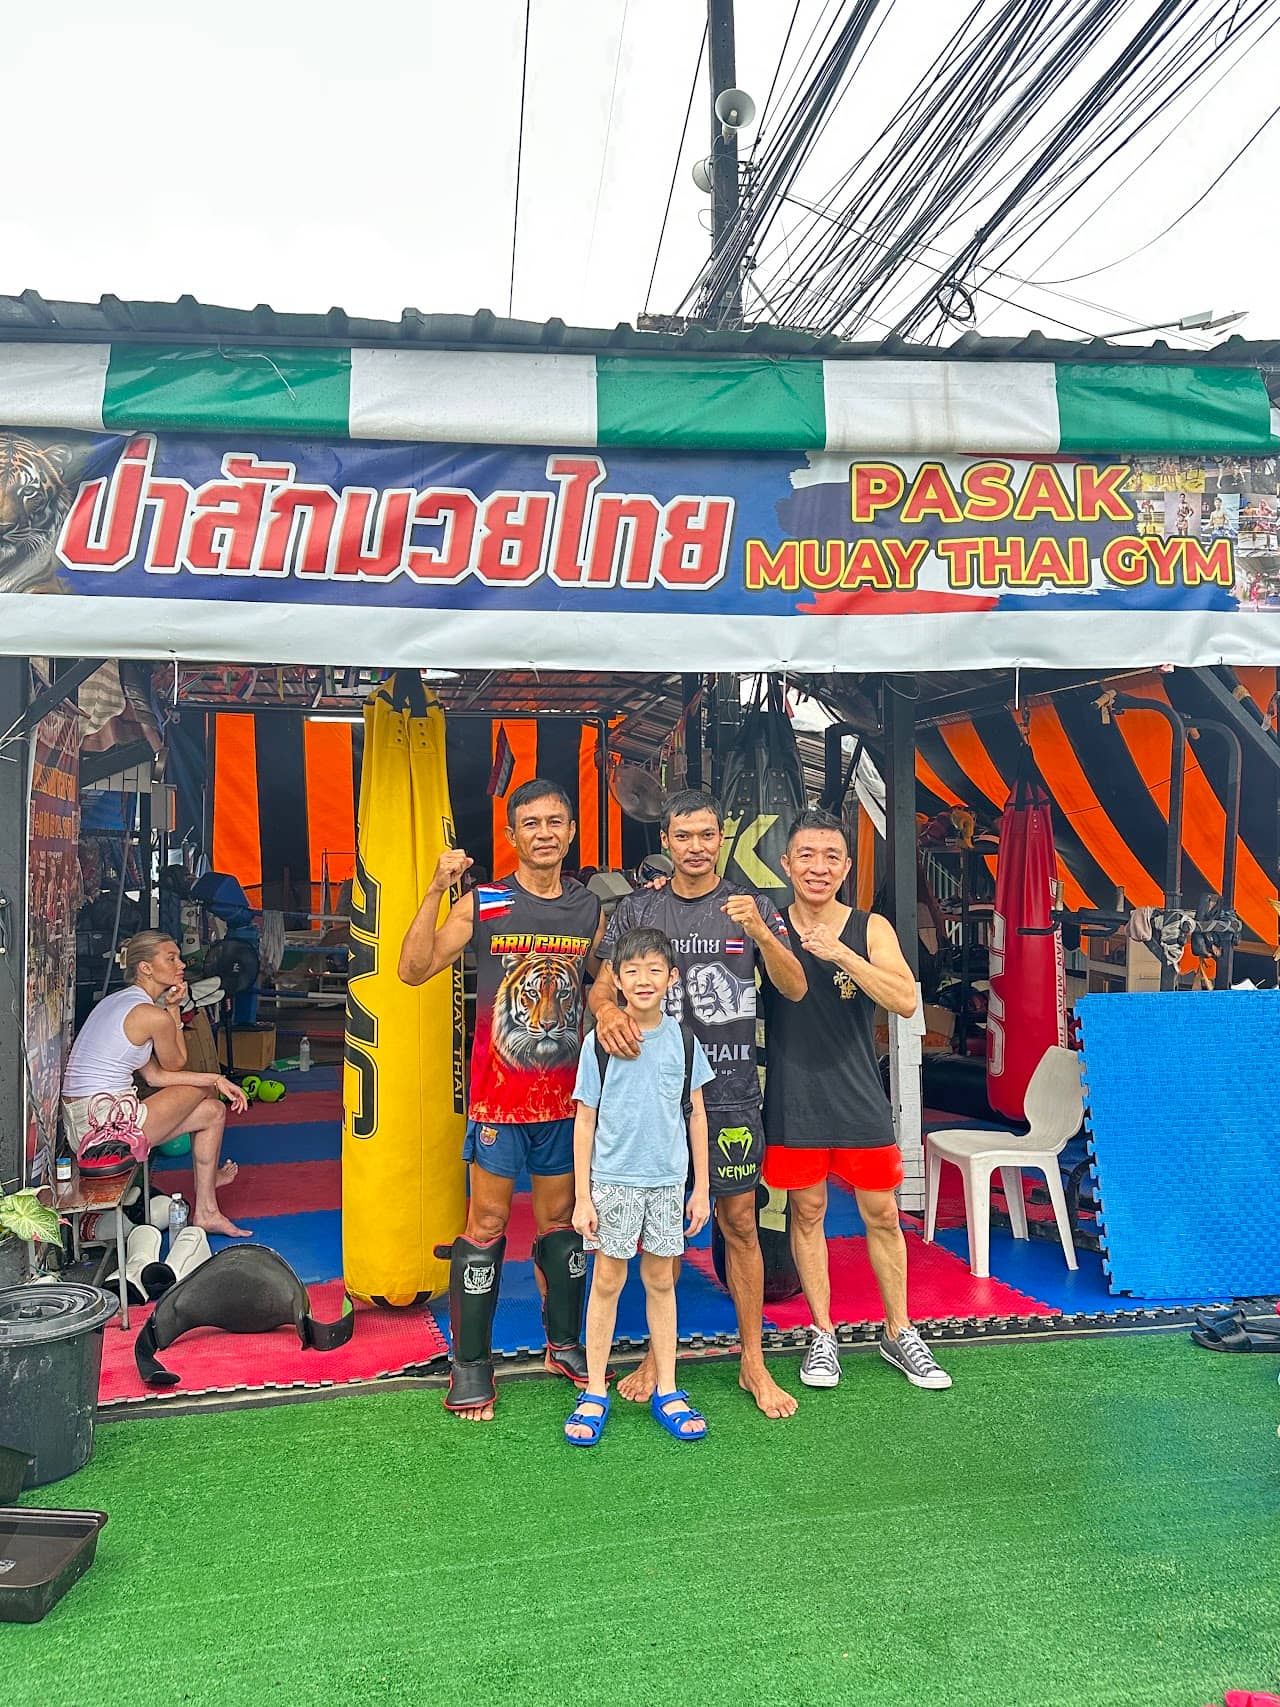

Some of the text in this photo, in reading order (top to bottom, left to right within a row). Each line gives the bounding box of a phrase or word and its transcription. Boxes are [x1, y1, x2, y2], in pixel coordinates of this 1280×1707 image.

[55, 433, 735, 590] ป่าสักมวยไทย
[850, 461, 1134, 523] PASAK
[744, 535, 1233, 590] MUAY THAI GYM
[490, 934, 591, 957] KRU CHART
[670, 932, 720, 954] วยไทย
[453, 969, 463, 1099] MUAY THAI
[717, 1162, 757, 1181] VENUM
